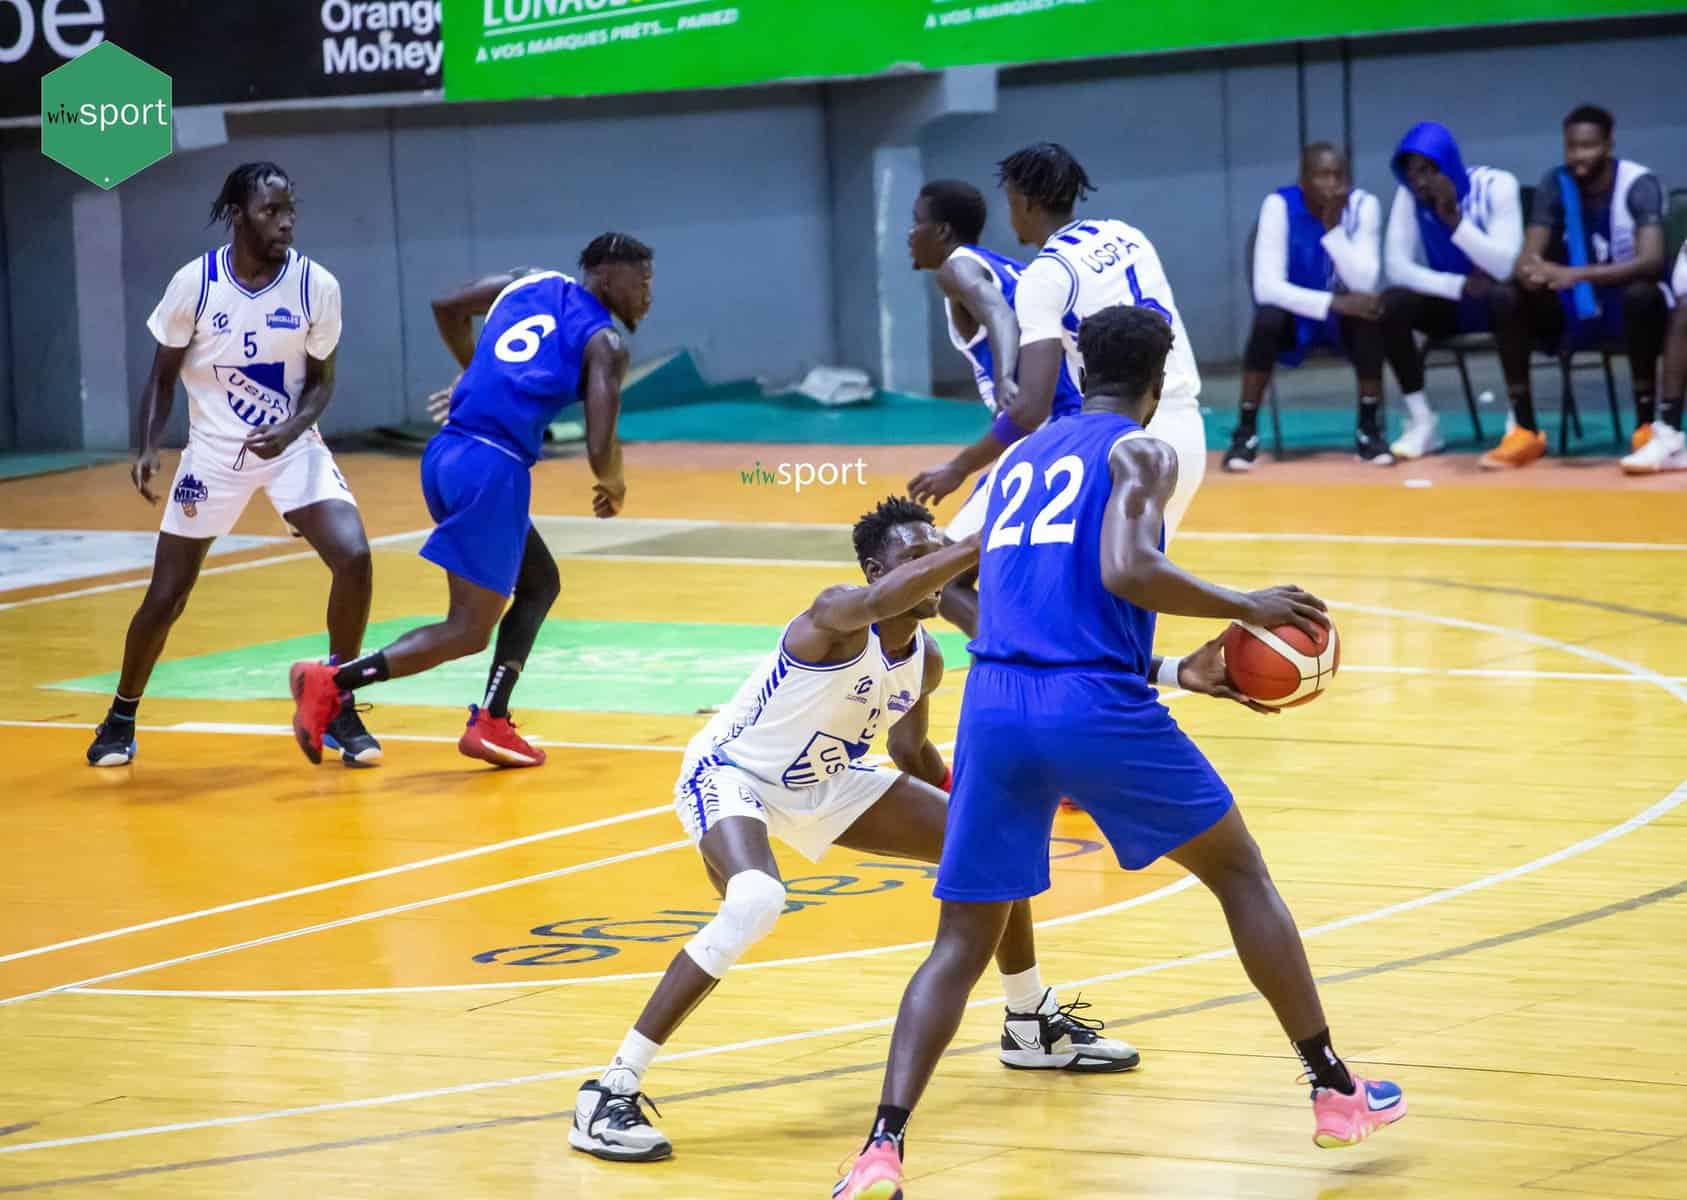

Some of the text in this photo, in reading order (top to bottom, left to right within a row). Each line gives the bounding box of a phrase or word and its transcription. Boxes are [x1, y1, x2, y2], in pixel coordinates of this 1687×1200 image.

[322, 37, 444, 75] Money
[491, 42, 525, 60] VOS
[527, 29, 608, 54] MARQUES
[243, 331, 258, 358] 5
[495, 314, 556, 362] 6
[228, 372, 285, 414] USPA
[986, 455, 1086, 552] 22
